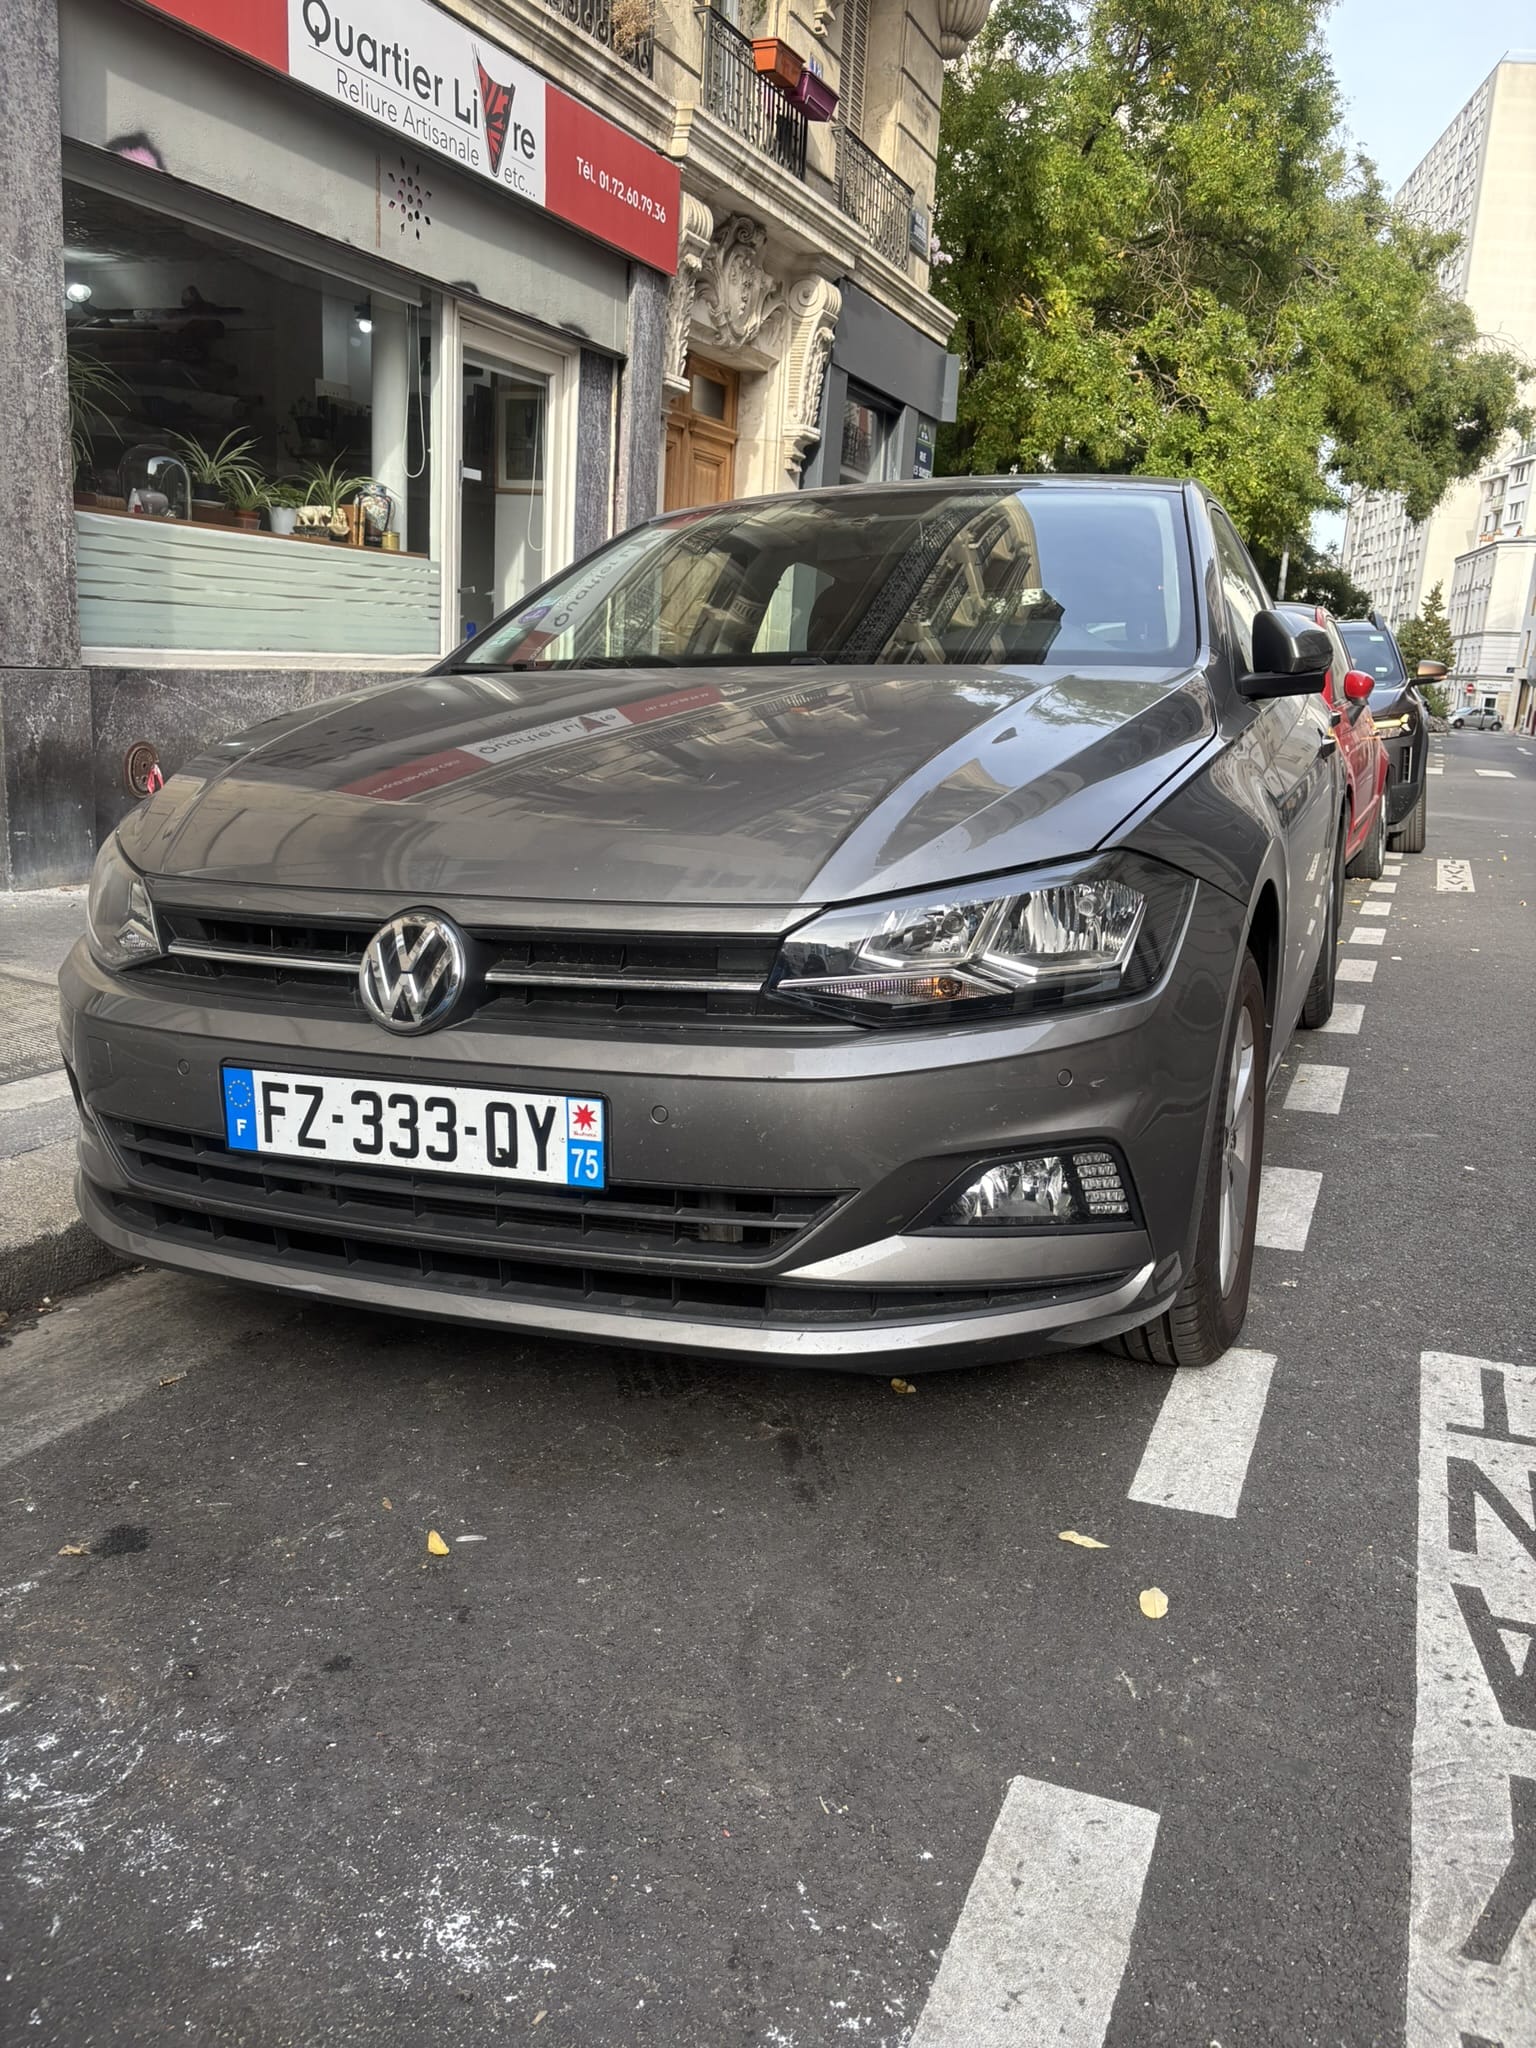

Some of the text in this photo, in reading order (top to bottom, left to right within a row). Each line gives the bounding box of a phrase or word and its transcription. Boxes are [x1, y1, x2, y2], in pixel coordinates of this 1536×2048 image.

[302, 0, 443, 107] Quartier
[337, 68, 536, 198] Reliure Artisanale etc...
[576, 155, 667, 224] Tél. 01.72.60.79.36
[363, 914, 461, 1031] VW
[236, 1080, 557, 1172] F FZ-333-QY
[570, 1147, 599, 1180] 75
